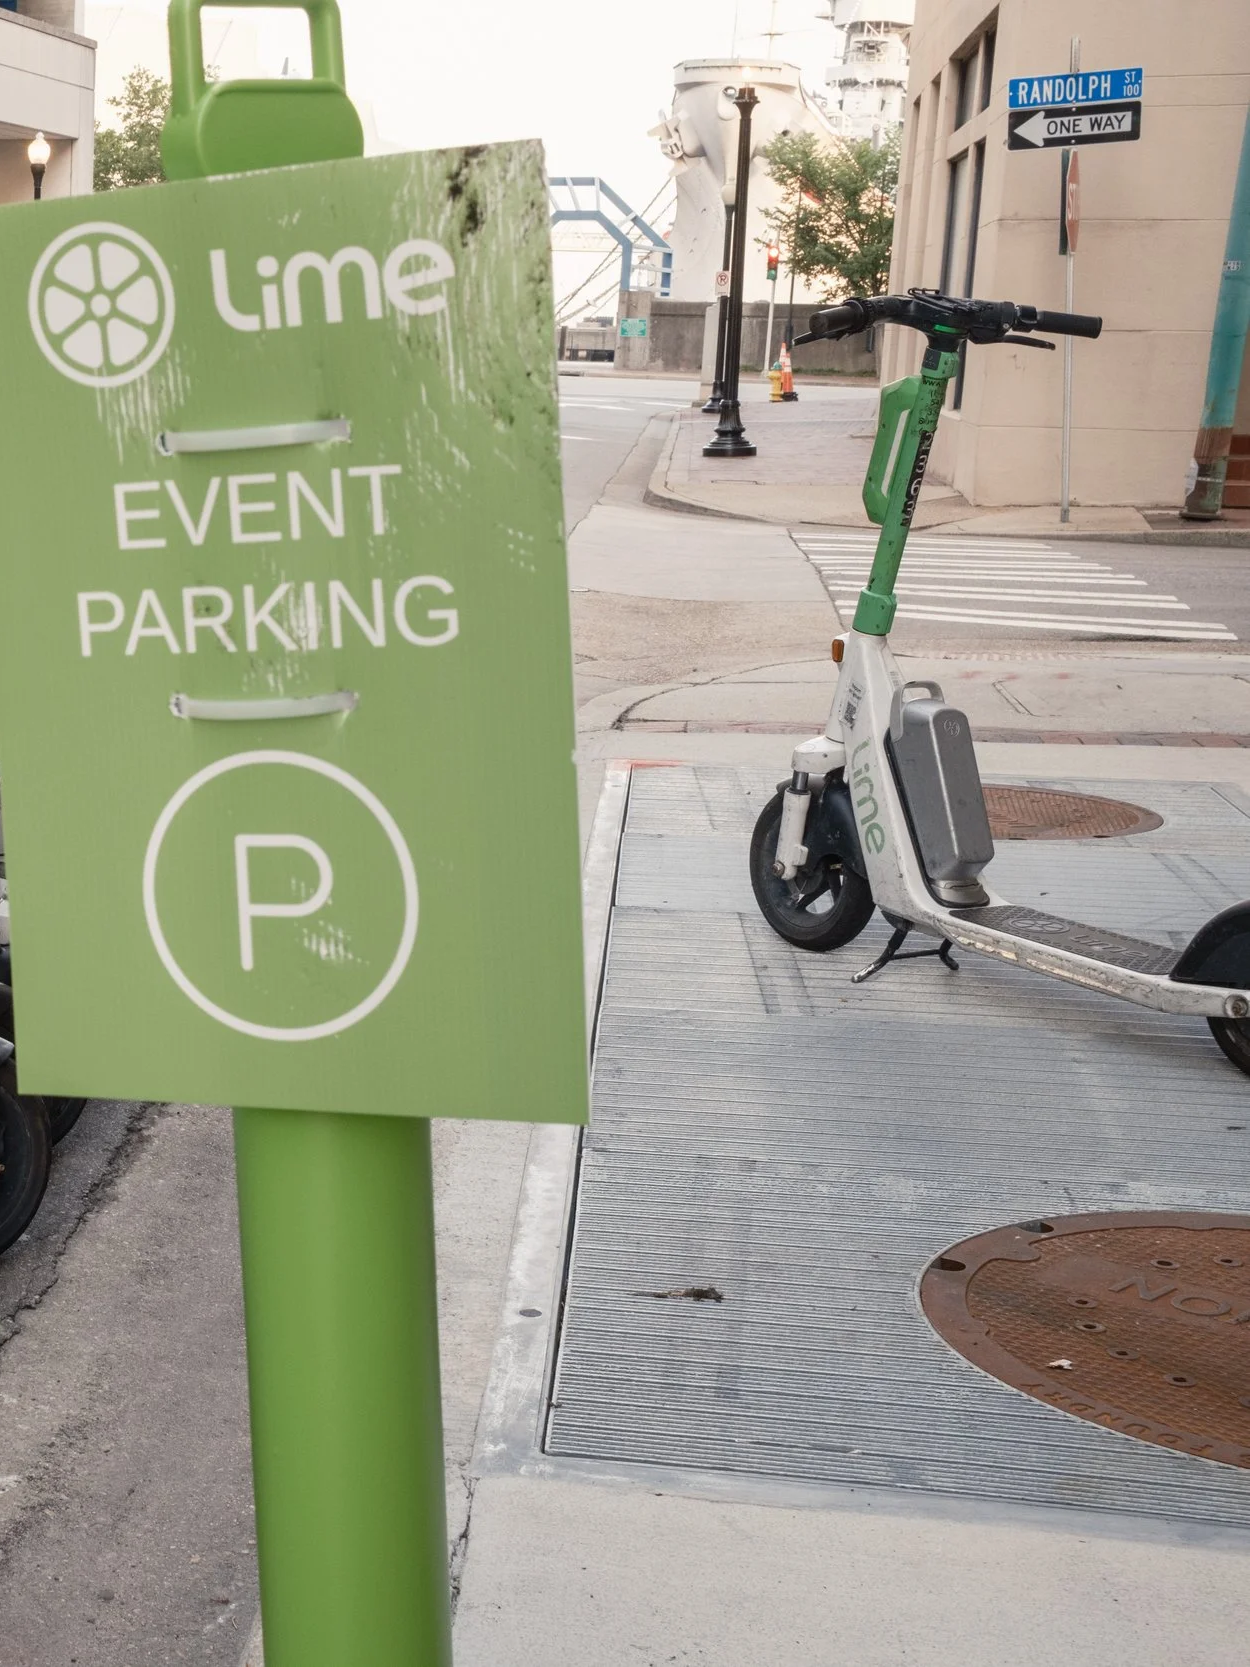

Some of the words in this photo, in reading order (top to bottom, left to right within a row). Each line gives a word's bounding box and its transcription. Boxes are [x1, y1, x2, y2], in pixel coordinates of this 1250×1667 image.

[1018, 74, 1111, 104] RANDOLPH
[1047, 118, 1082, 135] ONE
[1090, 114, 1126, 132] WAY
[1123, 84, 1139, 97] 100
[210, 239, 456, 331] Lime
[114, 464, 401, 550] EVENT
[77, 575, 460, 657] PARKING
[851, 740, 886, 855] Lime
[235, 834, 333, 971] P
